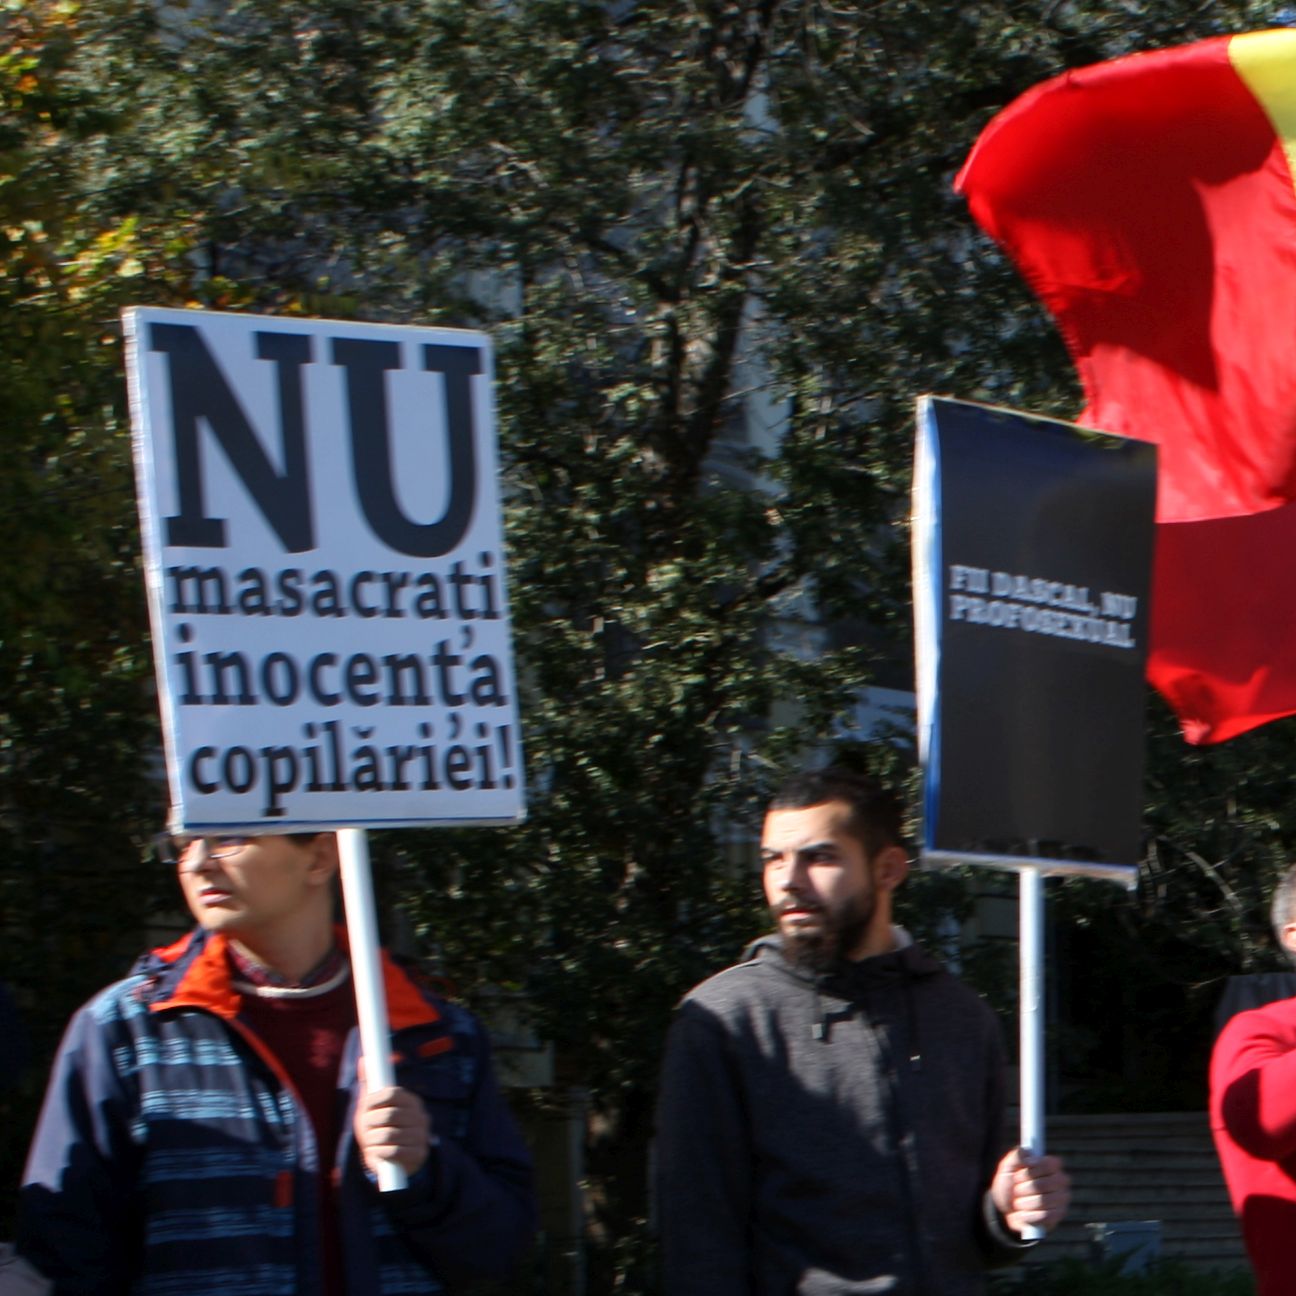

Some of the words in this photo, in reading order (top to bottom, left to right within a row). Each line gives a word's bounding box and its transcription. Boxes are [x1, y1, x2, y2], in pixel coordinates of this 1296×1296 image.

[149, 321, 486, 558] NU
[166, 551, 502, 651] masacrați
[172, 622, 509, 740] inocența
[190, 718, 515, 817] copilăriei!
